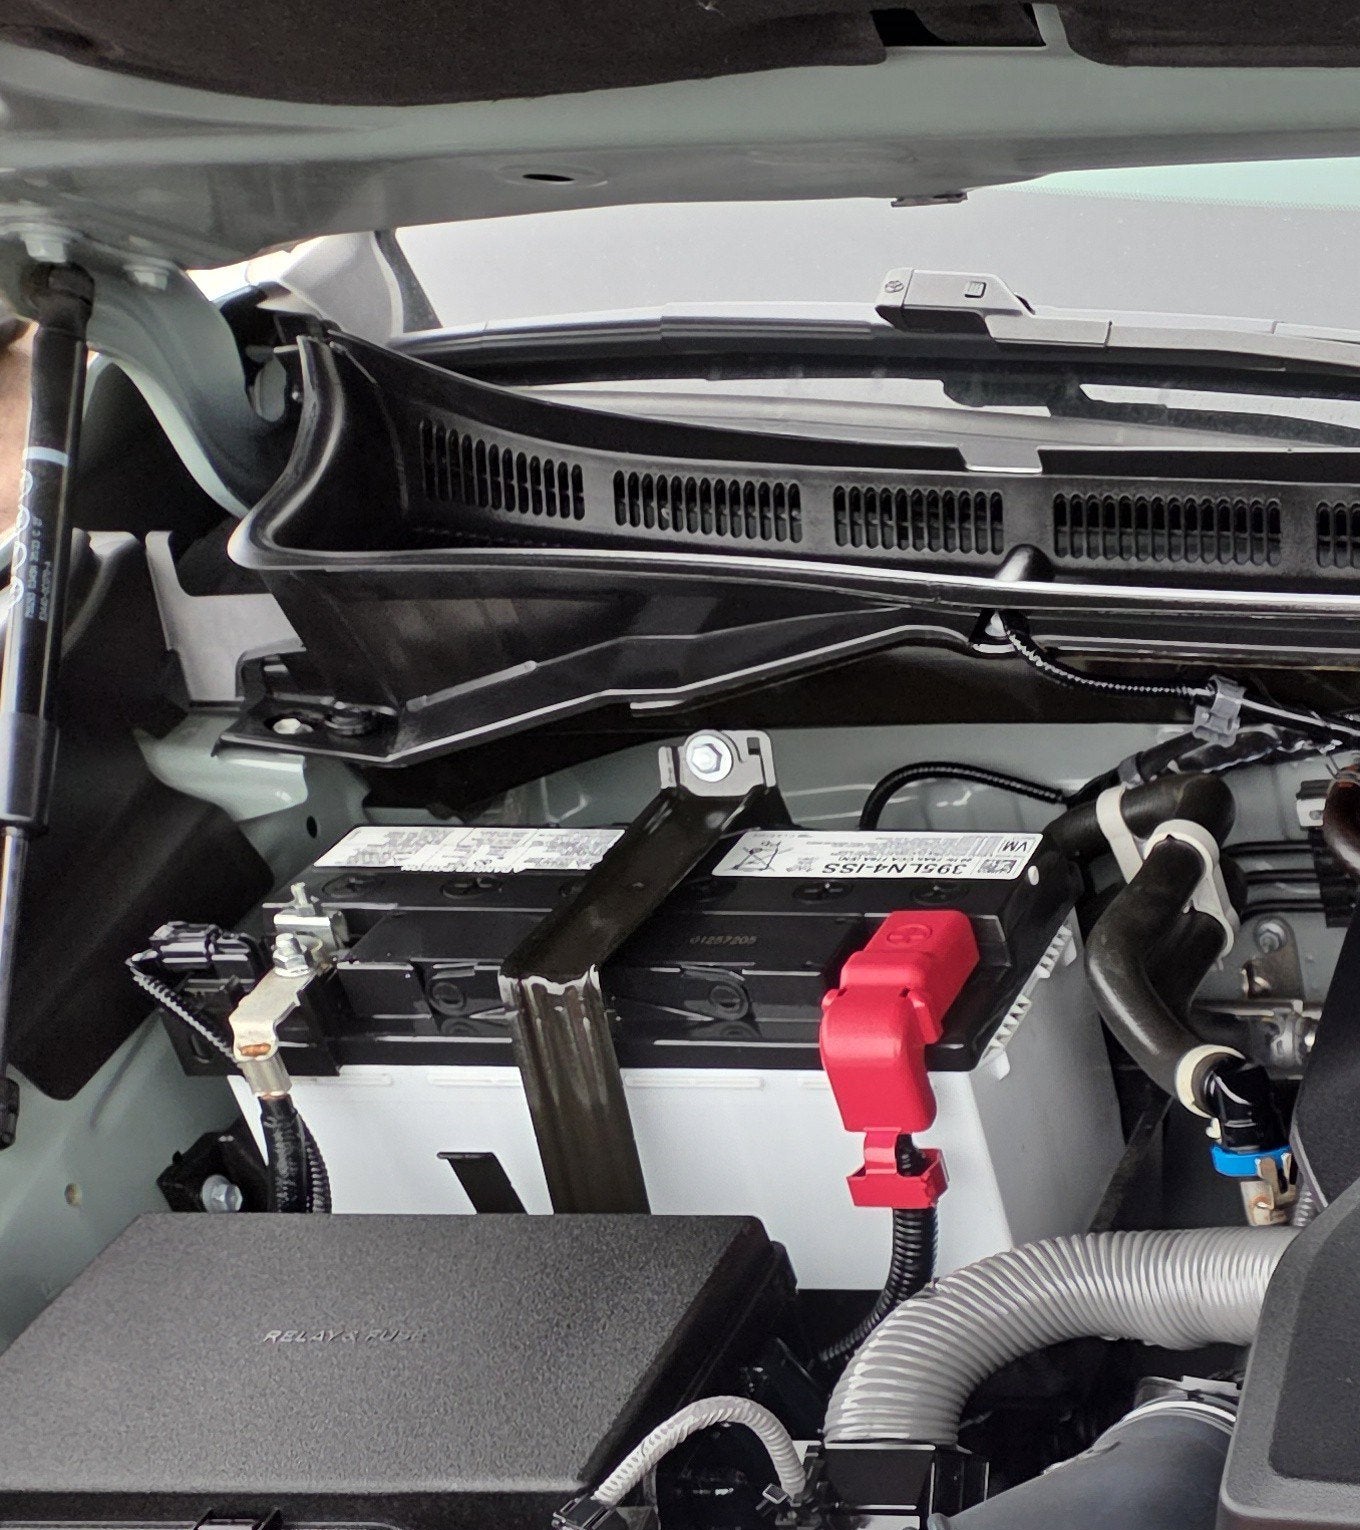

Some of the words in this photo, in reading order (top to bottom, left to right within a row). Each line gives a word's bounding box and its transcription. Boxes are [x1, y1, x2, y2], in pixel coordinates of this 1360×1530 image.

[1002, 841, 1028, 853] VM
[822, 862, 967, 875] 395LN4-ISS
[263, 1329, 344, 1344] RELAY
